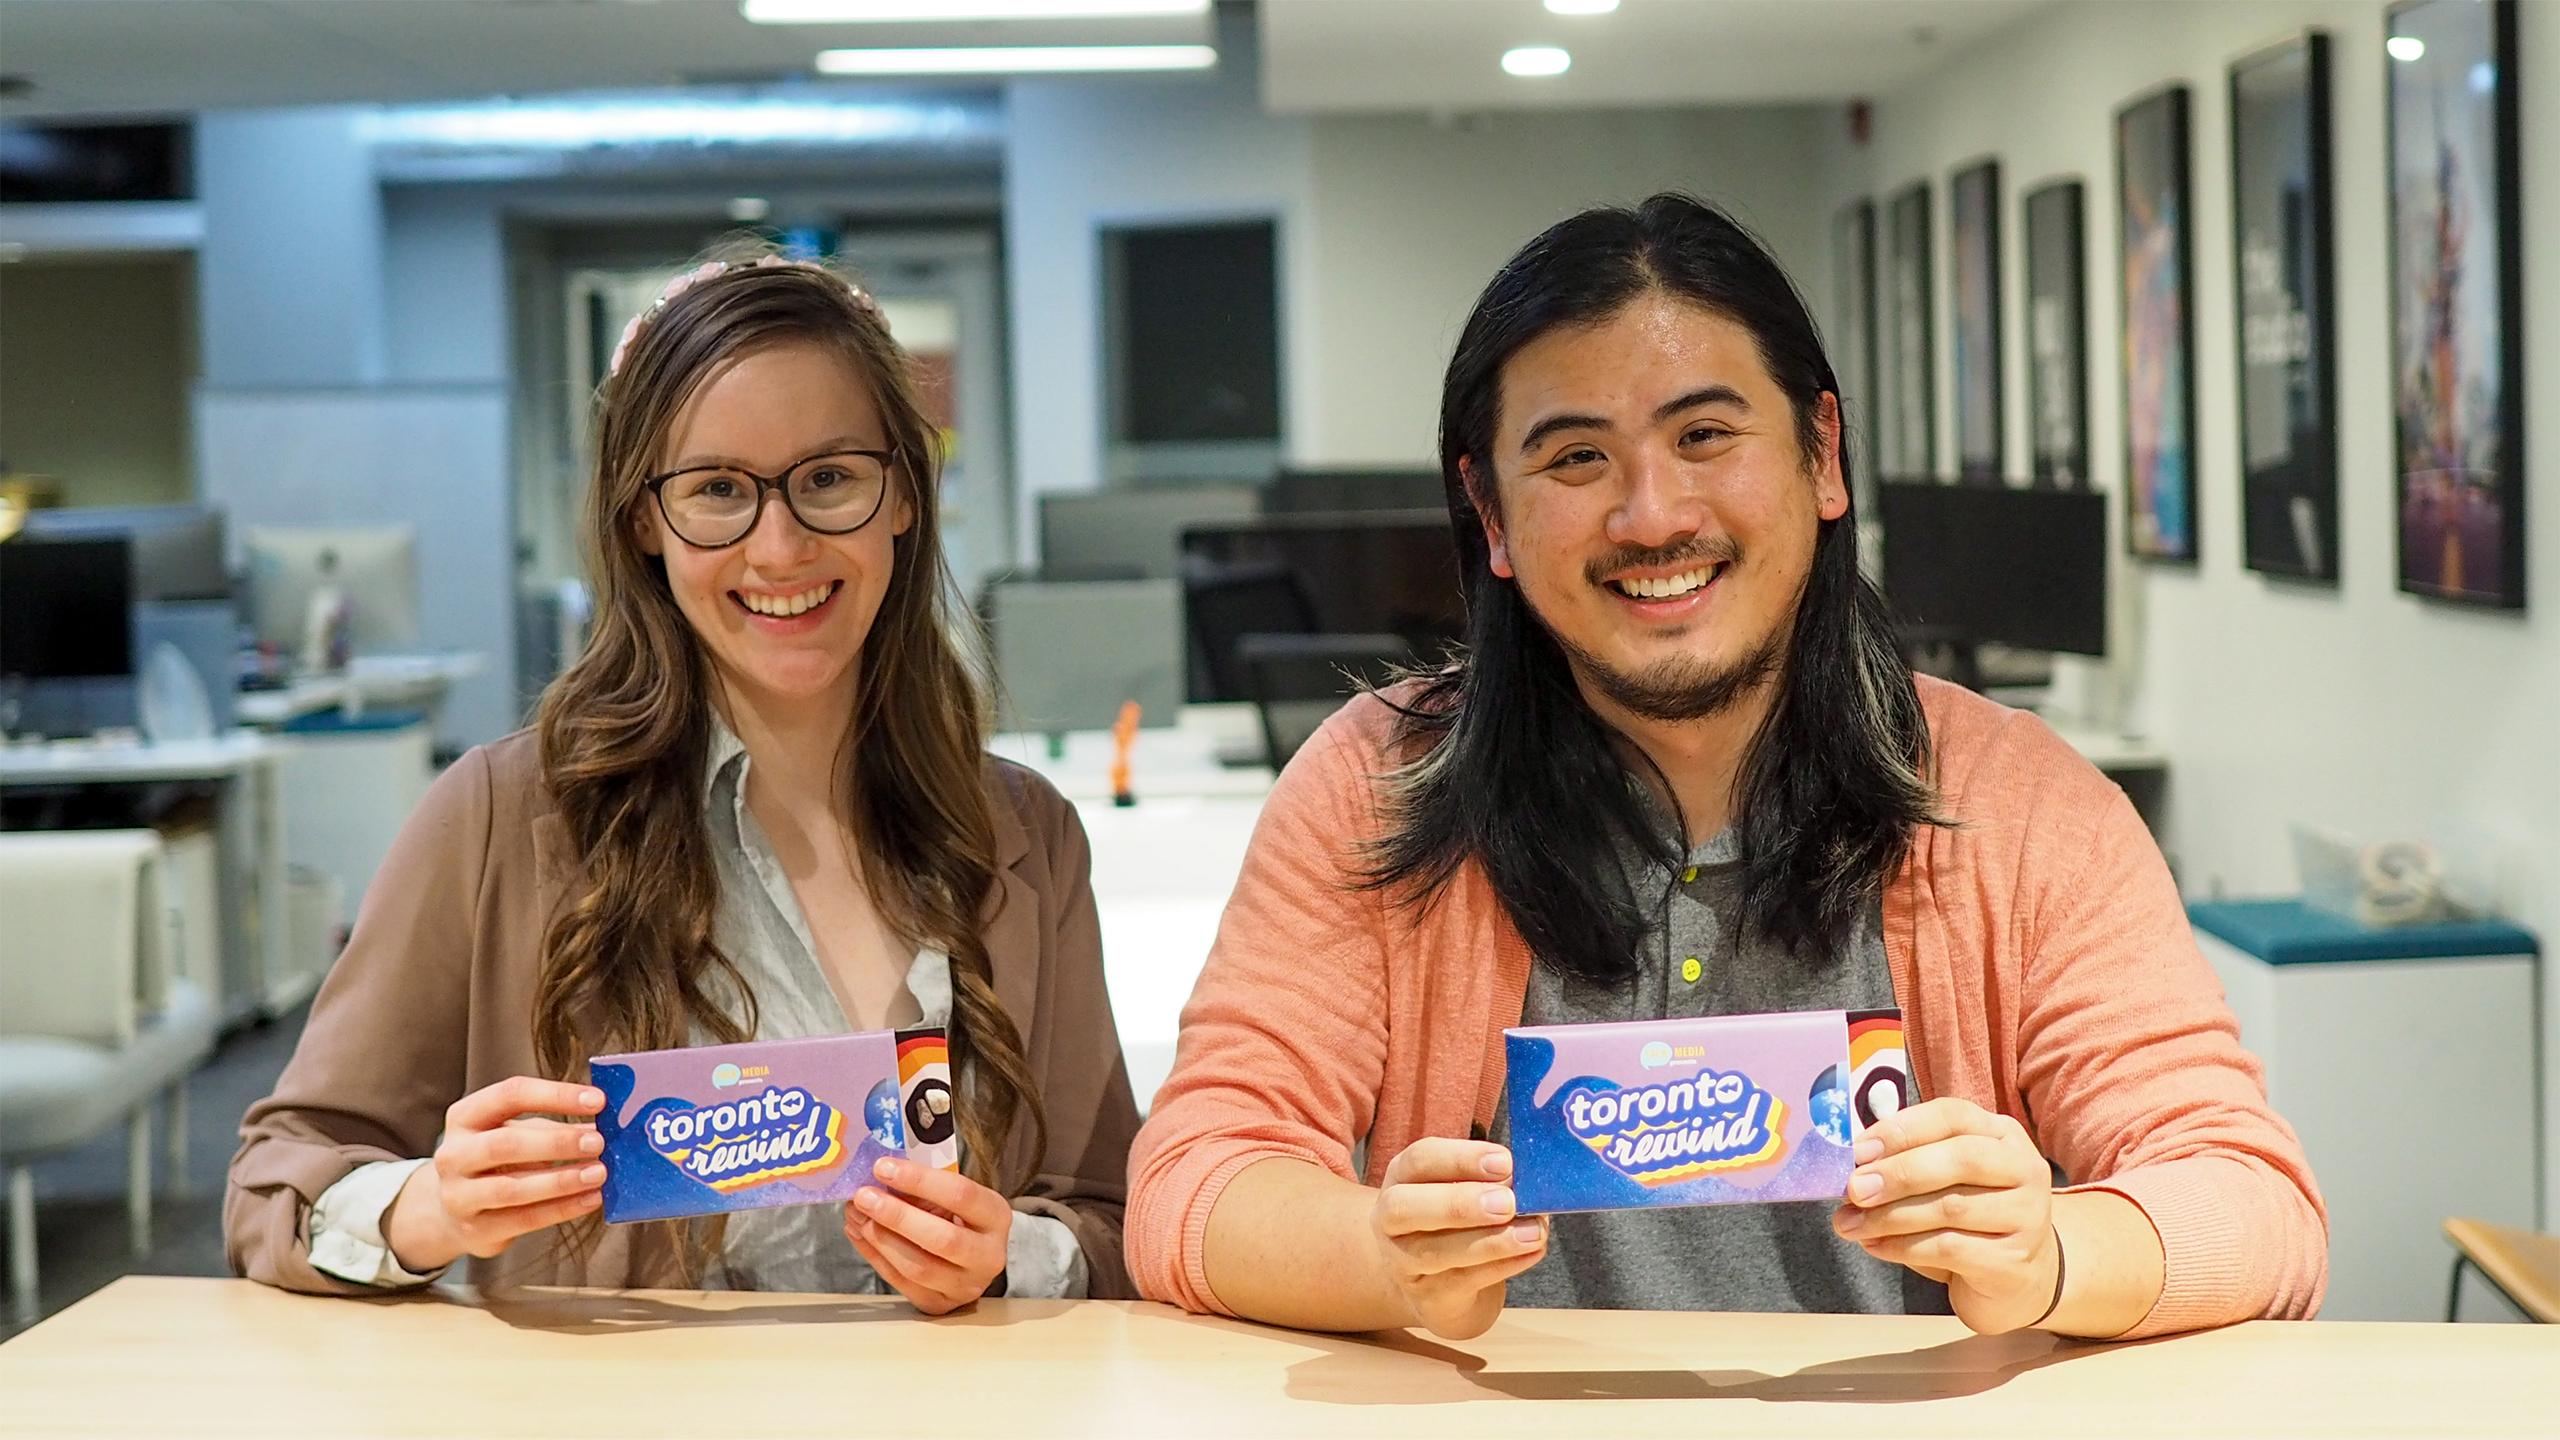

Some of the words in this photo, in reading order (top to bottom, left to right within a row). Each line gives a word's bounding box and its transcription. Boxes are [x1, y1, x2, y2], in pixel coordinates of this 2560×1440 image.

[741, 1065, 770, 1078] MEDIA
[1674, 1045, 1706, 1058] MEDIA
[651, 1088, 806, 1145] toronto
[1570, 1072, 1744, 1129] toronto
[1607, 1093, 1759, 1165] rewind
[686, 1106, 821, 1176] rewind
